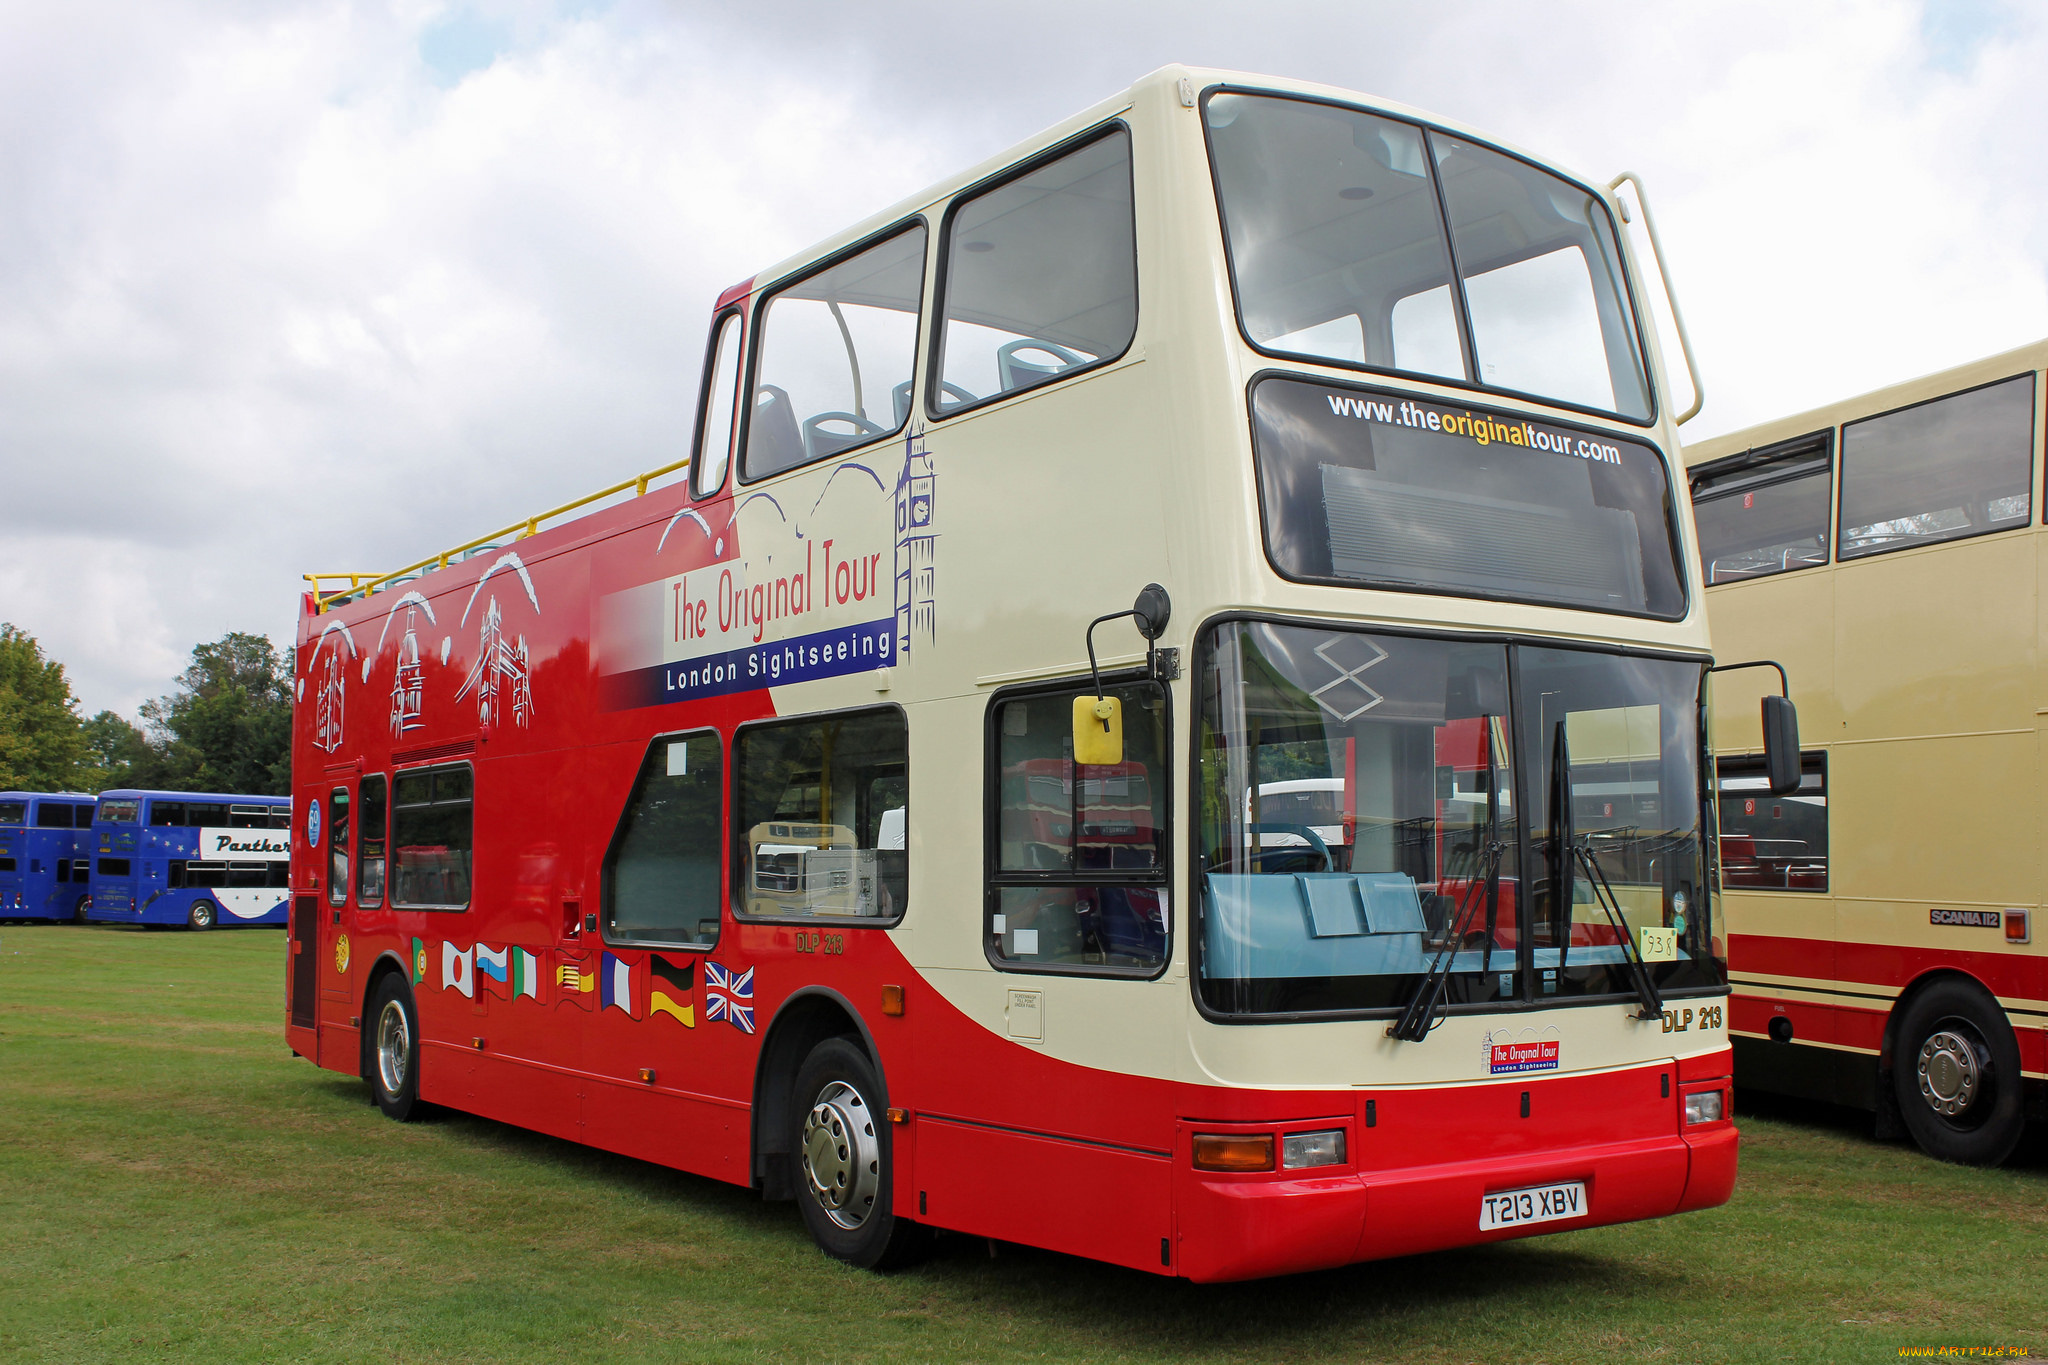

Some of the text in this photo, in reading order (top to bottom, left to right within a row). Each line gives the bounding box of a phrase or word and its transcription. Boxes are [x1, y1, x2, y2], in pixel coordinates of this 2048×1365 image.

[1327, 394, 1621, 465] www.theoriginaltour.com
[673, 538, 880, 643] The Original Tour
[667, 631, 890, 691] London Sightseeing
[1931, 910, 1998, 926] SCANIA 112
[796, 932, 843, 955] DLP 213
[1647, 935, 1672, 956] 938
[1662, 1005, 1722, 1033] DLP 213
[1494, 1043, 1556, 1063] The Original Tour
[1493, 1061, 1556, 1072] London Sightseeing
[1485, 1187, 1577, 1223] T213 XBV
